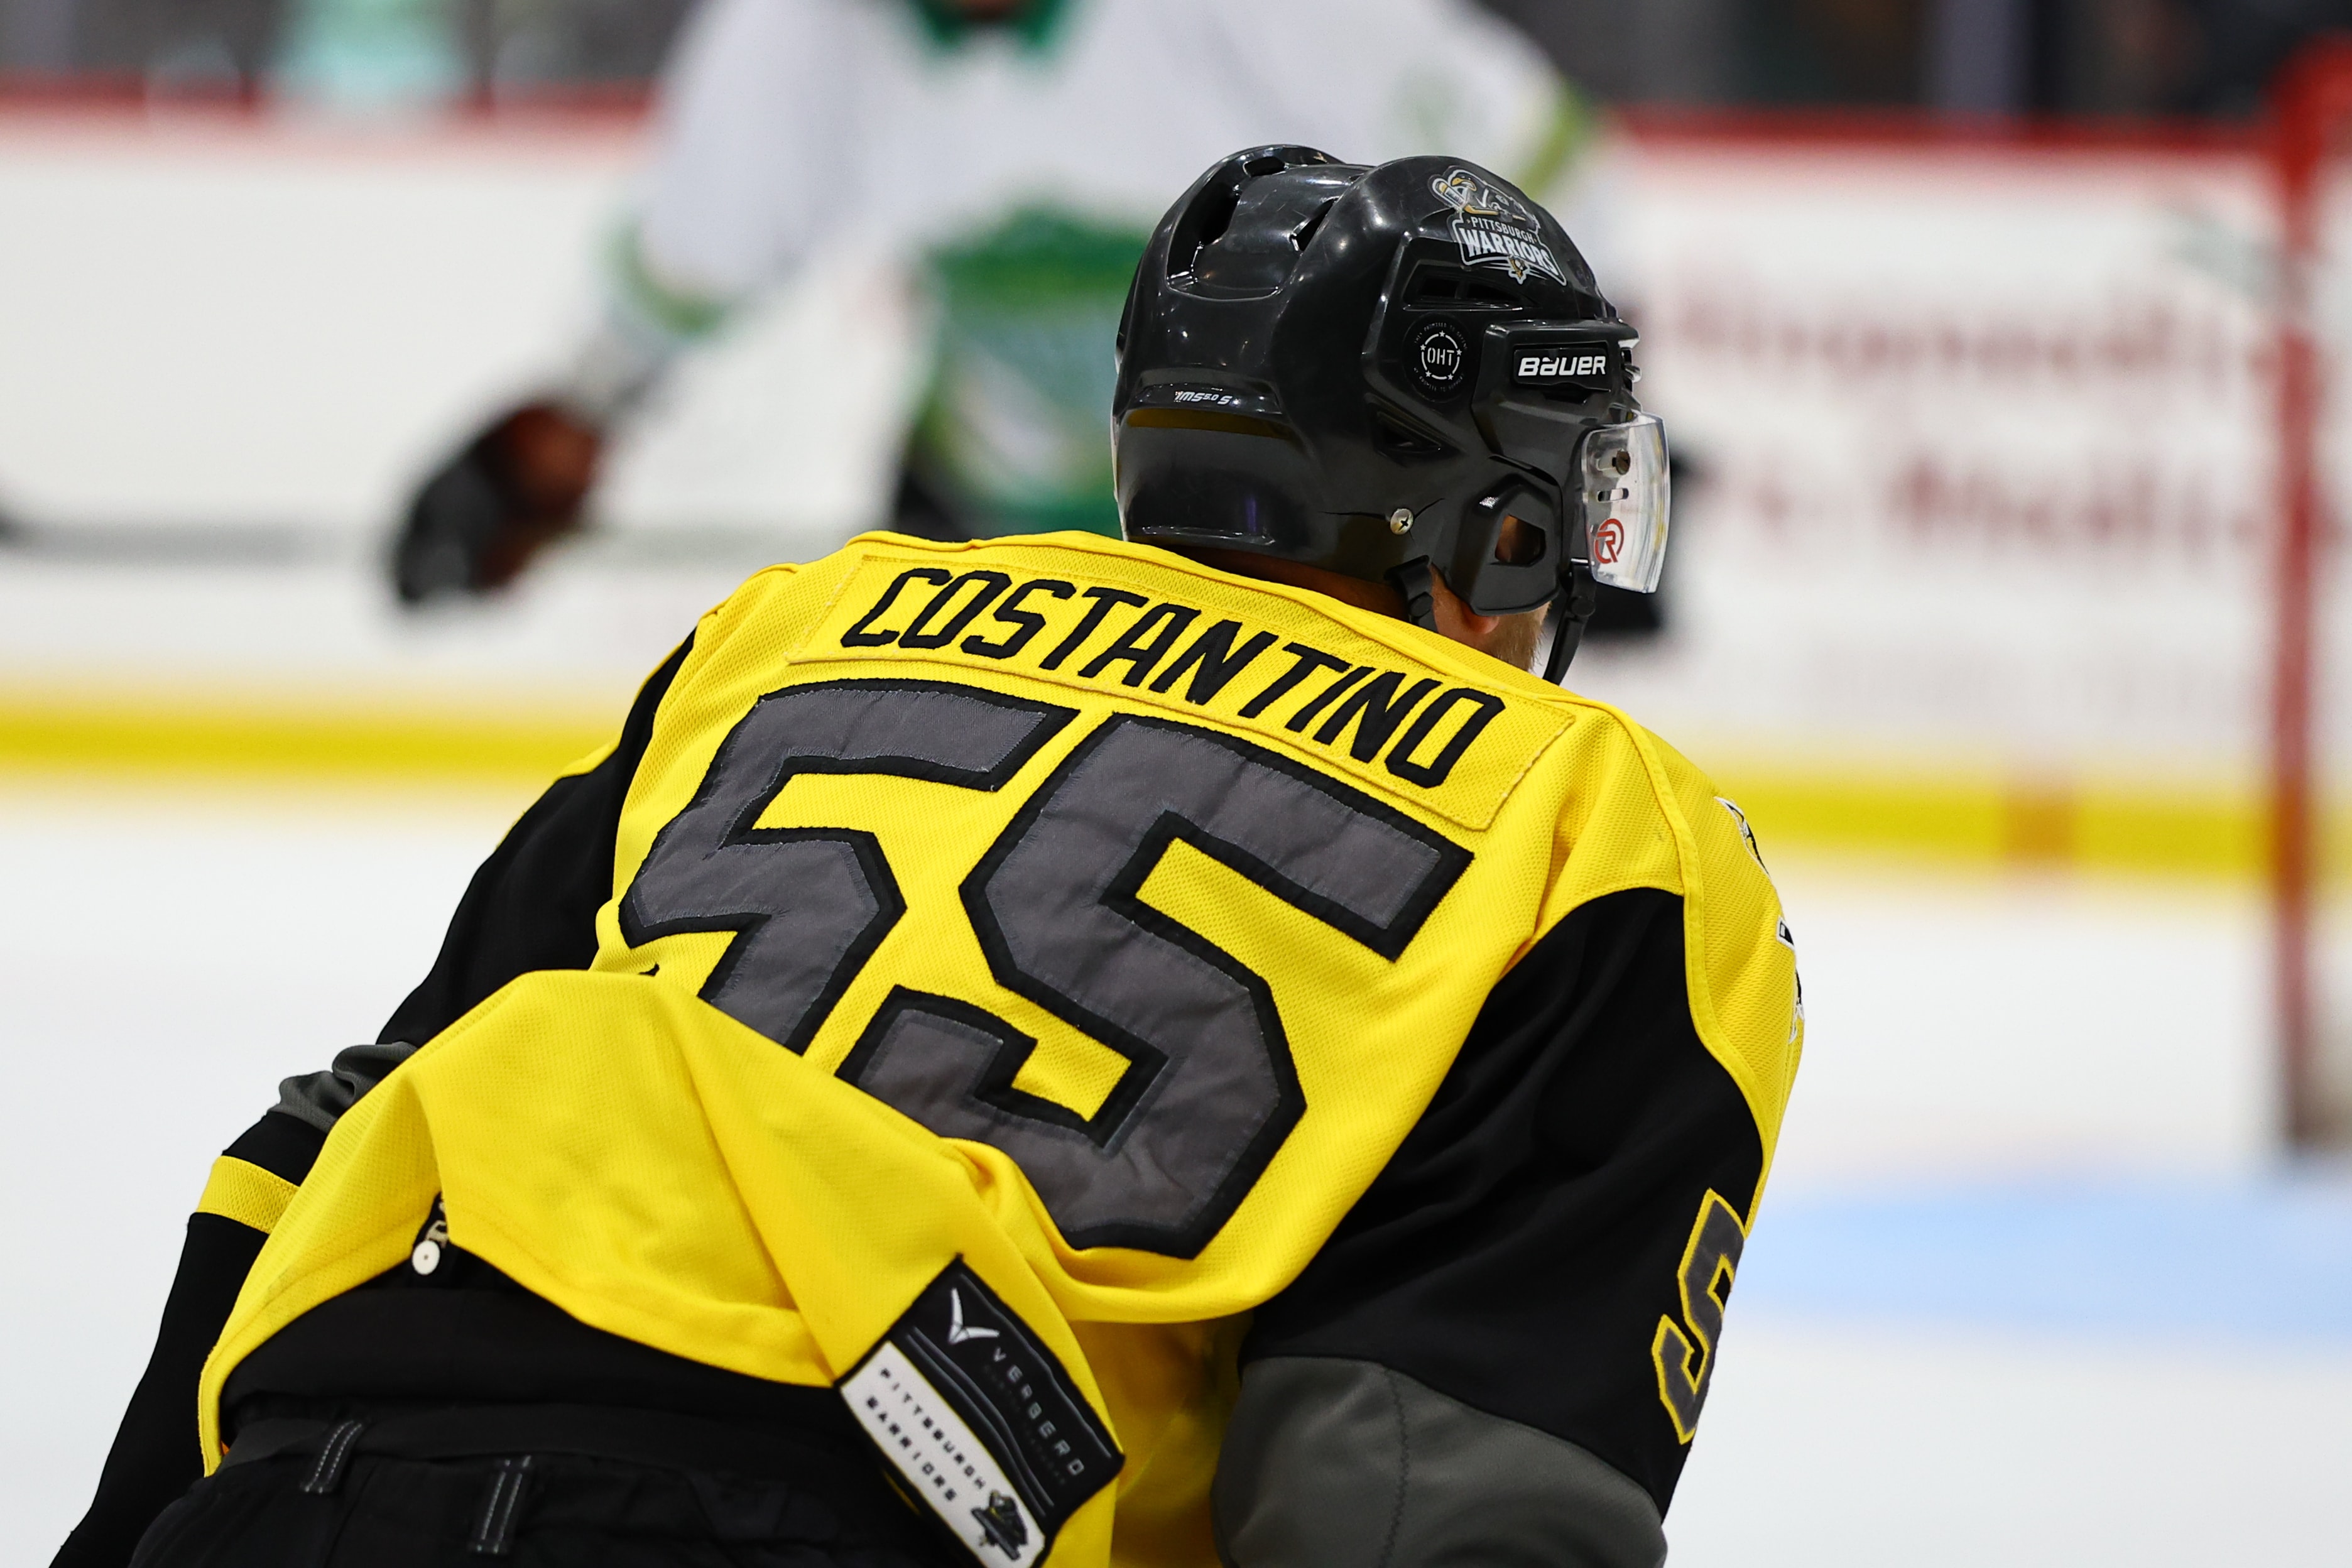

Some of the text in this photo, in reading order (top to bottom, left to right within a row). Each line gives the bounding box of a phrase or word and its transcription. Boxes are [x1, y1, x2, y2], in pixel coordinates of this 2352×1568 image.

[1459, 228, 1559, 276] WARRIORS
[1471, 217, 1535, 244] PITTSBURGH
[1427, 347, 1454, 366] OHT
[841, 568, 1505, 788] COSTANTINO
[618, 678, 1474, 1259] 55
